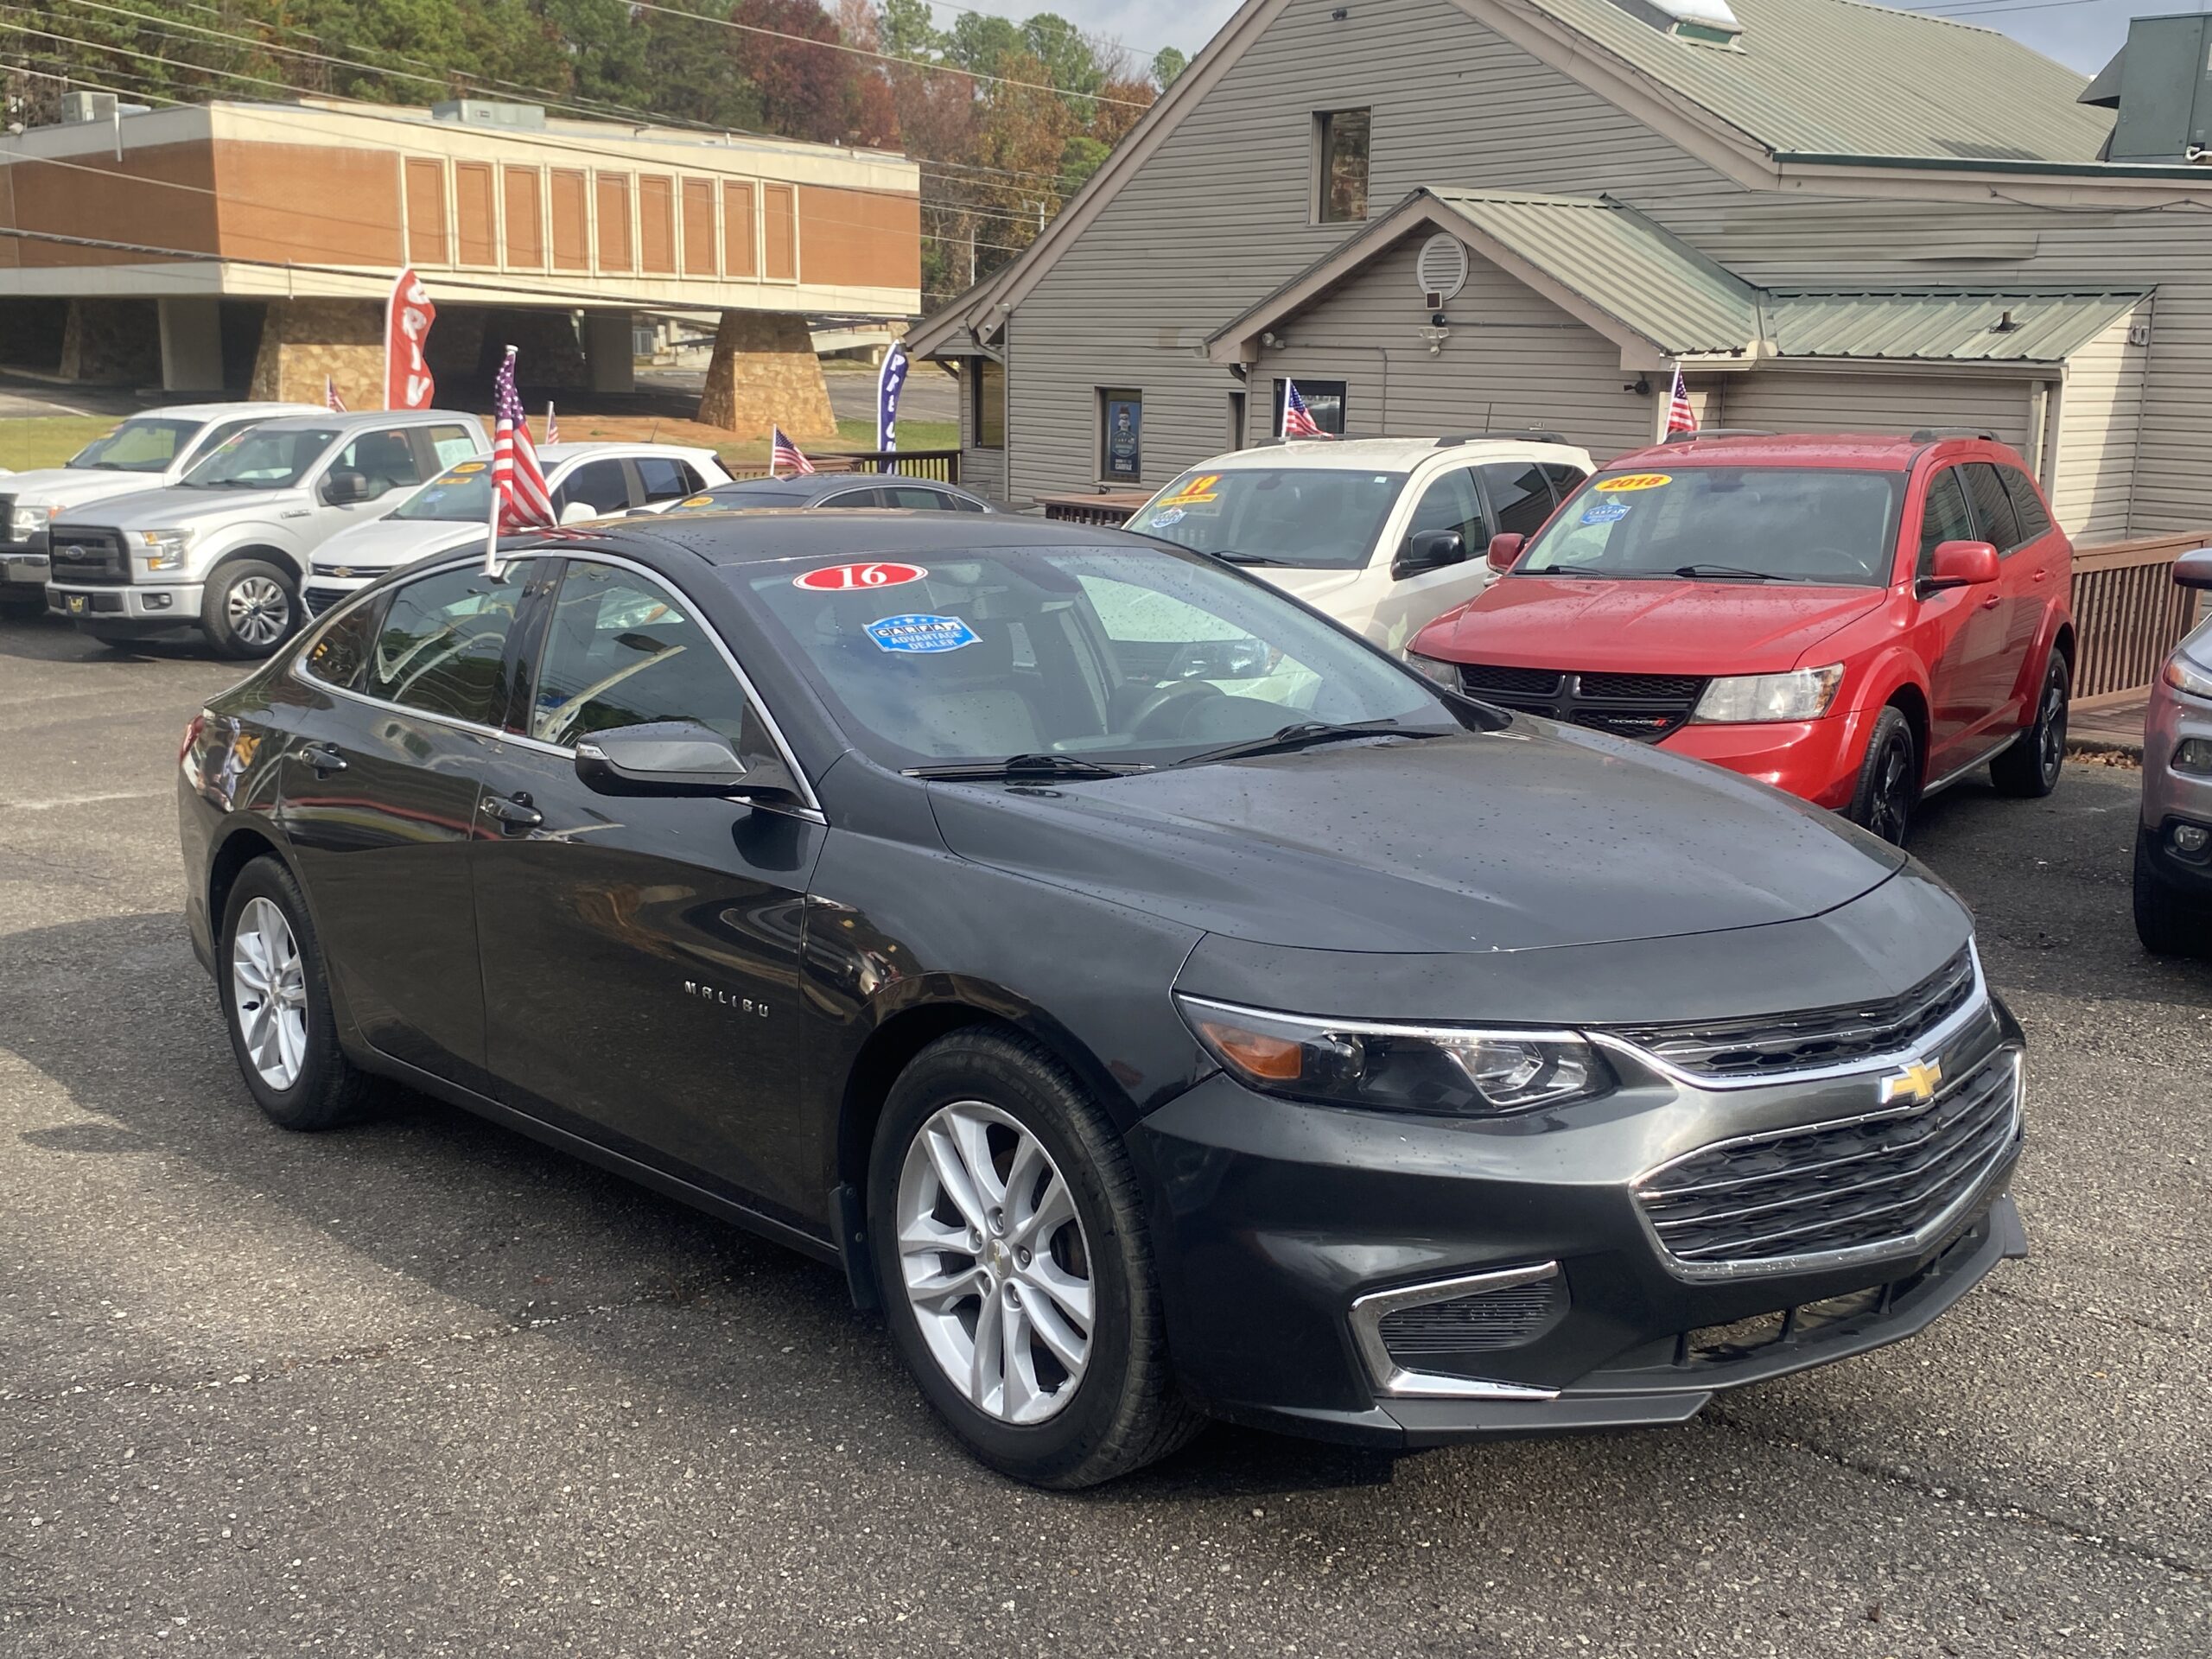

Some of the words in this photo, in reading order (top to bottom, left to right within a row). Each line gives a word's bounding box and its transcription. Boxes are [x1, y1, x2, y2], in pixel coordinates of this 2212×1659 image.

[1180, 474, 1218, 495] 19
[1602, 476, 1665, 490] 2018
[836, 563, 887, 589] 16
[875, 622, 962, 637] CARFAX
[891, 631, 963, 645] ADVANTAGE
[908, 639, 958, 650] DEALER
[684, 980, 769, 1018] MALIBU
